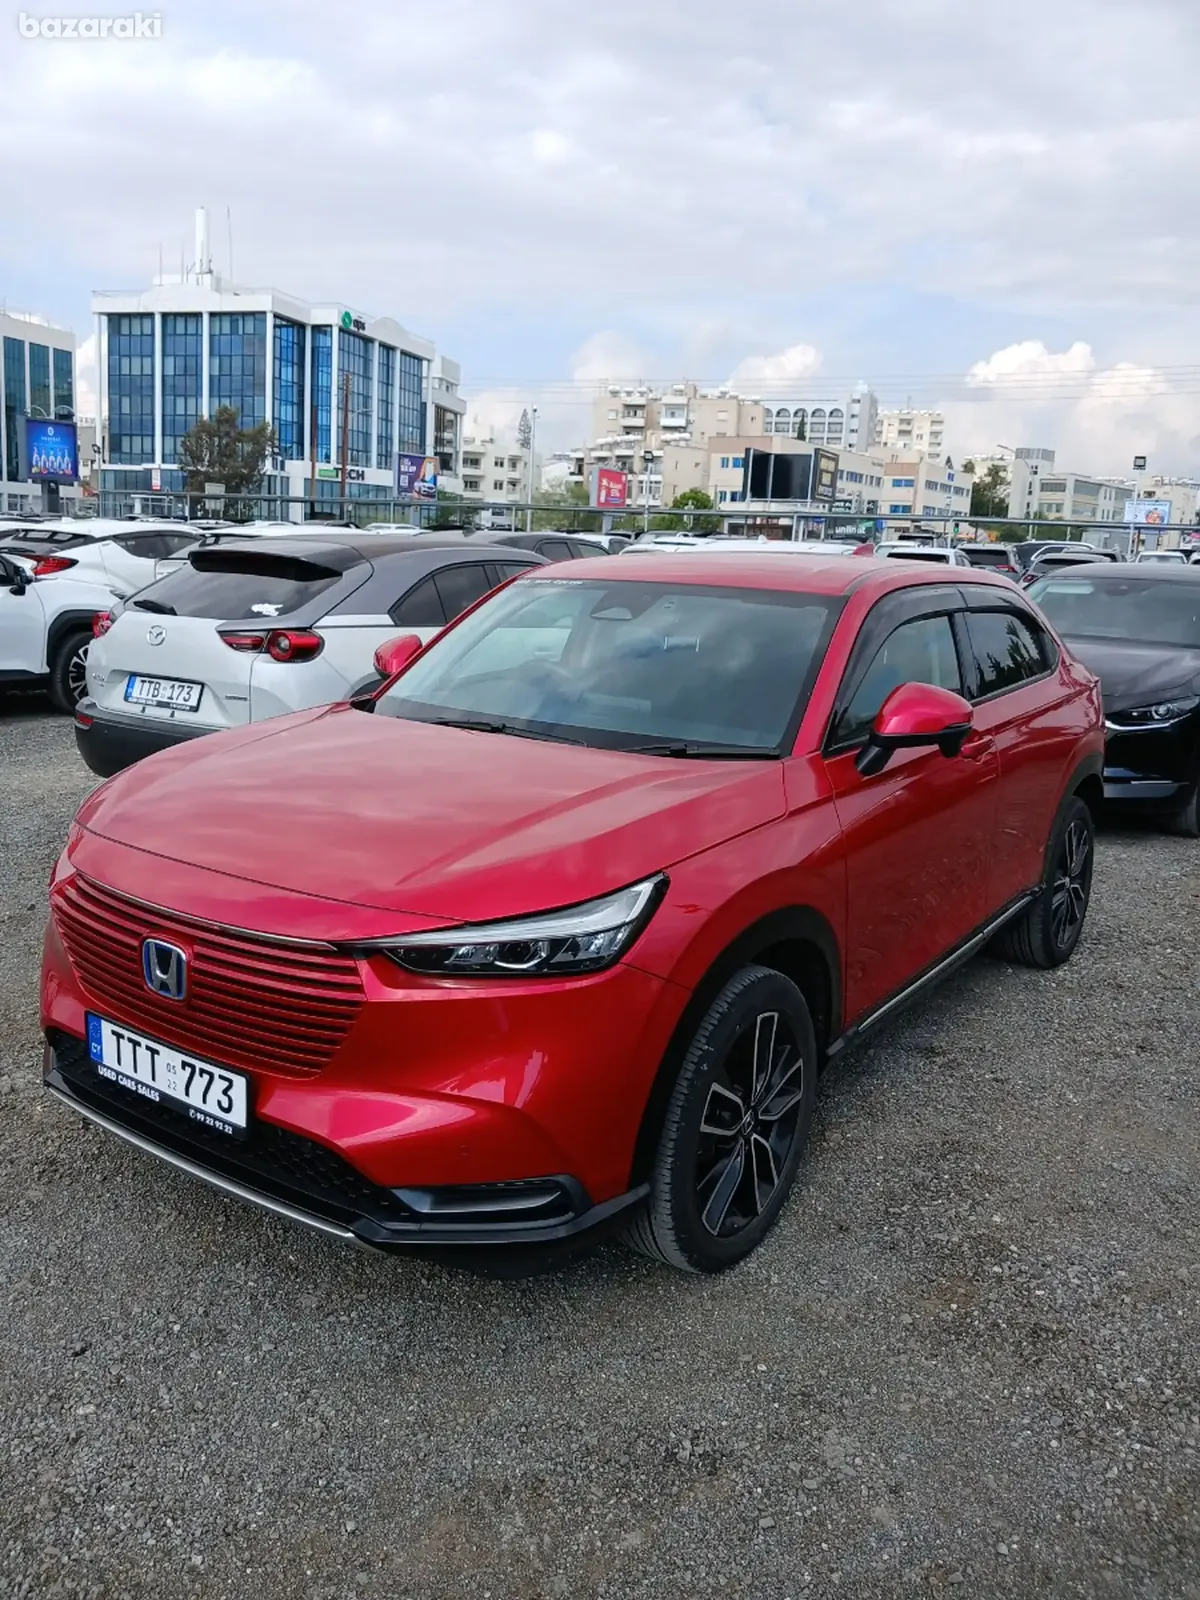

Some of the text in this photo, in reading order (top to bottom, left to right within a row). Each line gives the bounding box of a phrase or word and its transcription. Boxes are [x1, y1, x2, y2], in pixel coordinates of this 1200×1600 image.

[333, 467, 365, 481] TCH
[140, 680, 161, 698] TTB
[167, 684, 193, 702] 173
[98, 1064, 160, 1102] USED CARS SALES
[111, 1029, 160, 1083] TTT
[181, 1060, 234, 1114] 773
